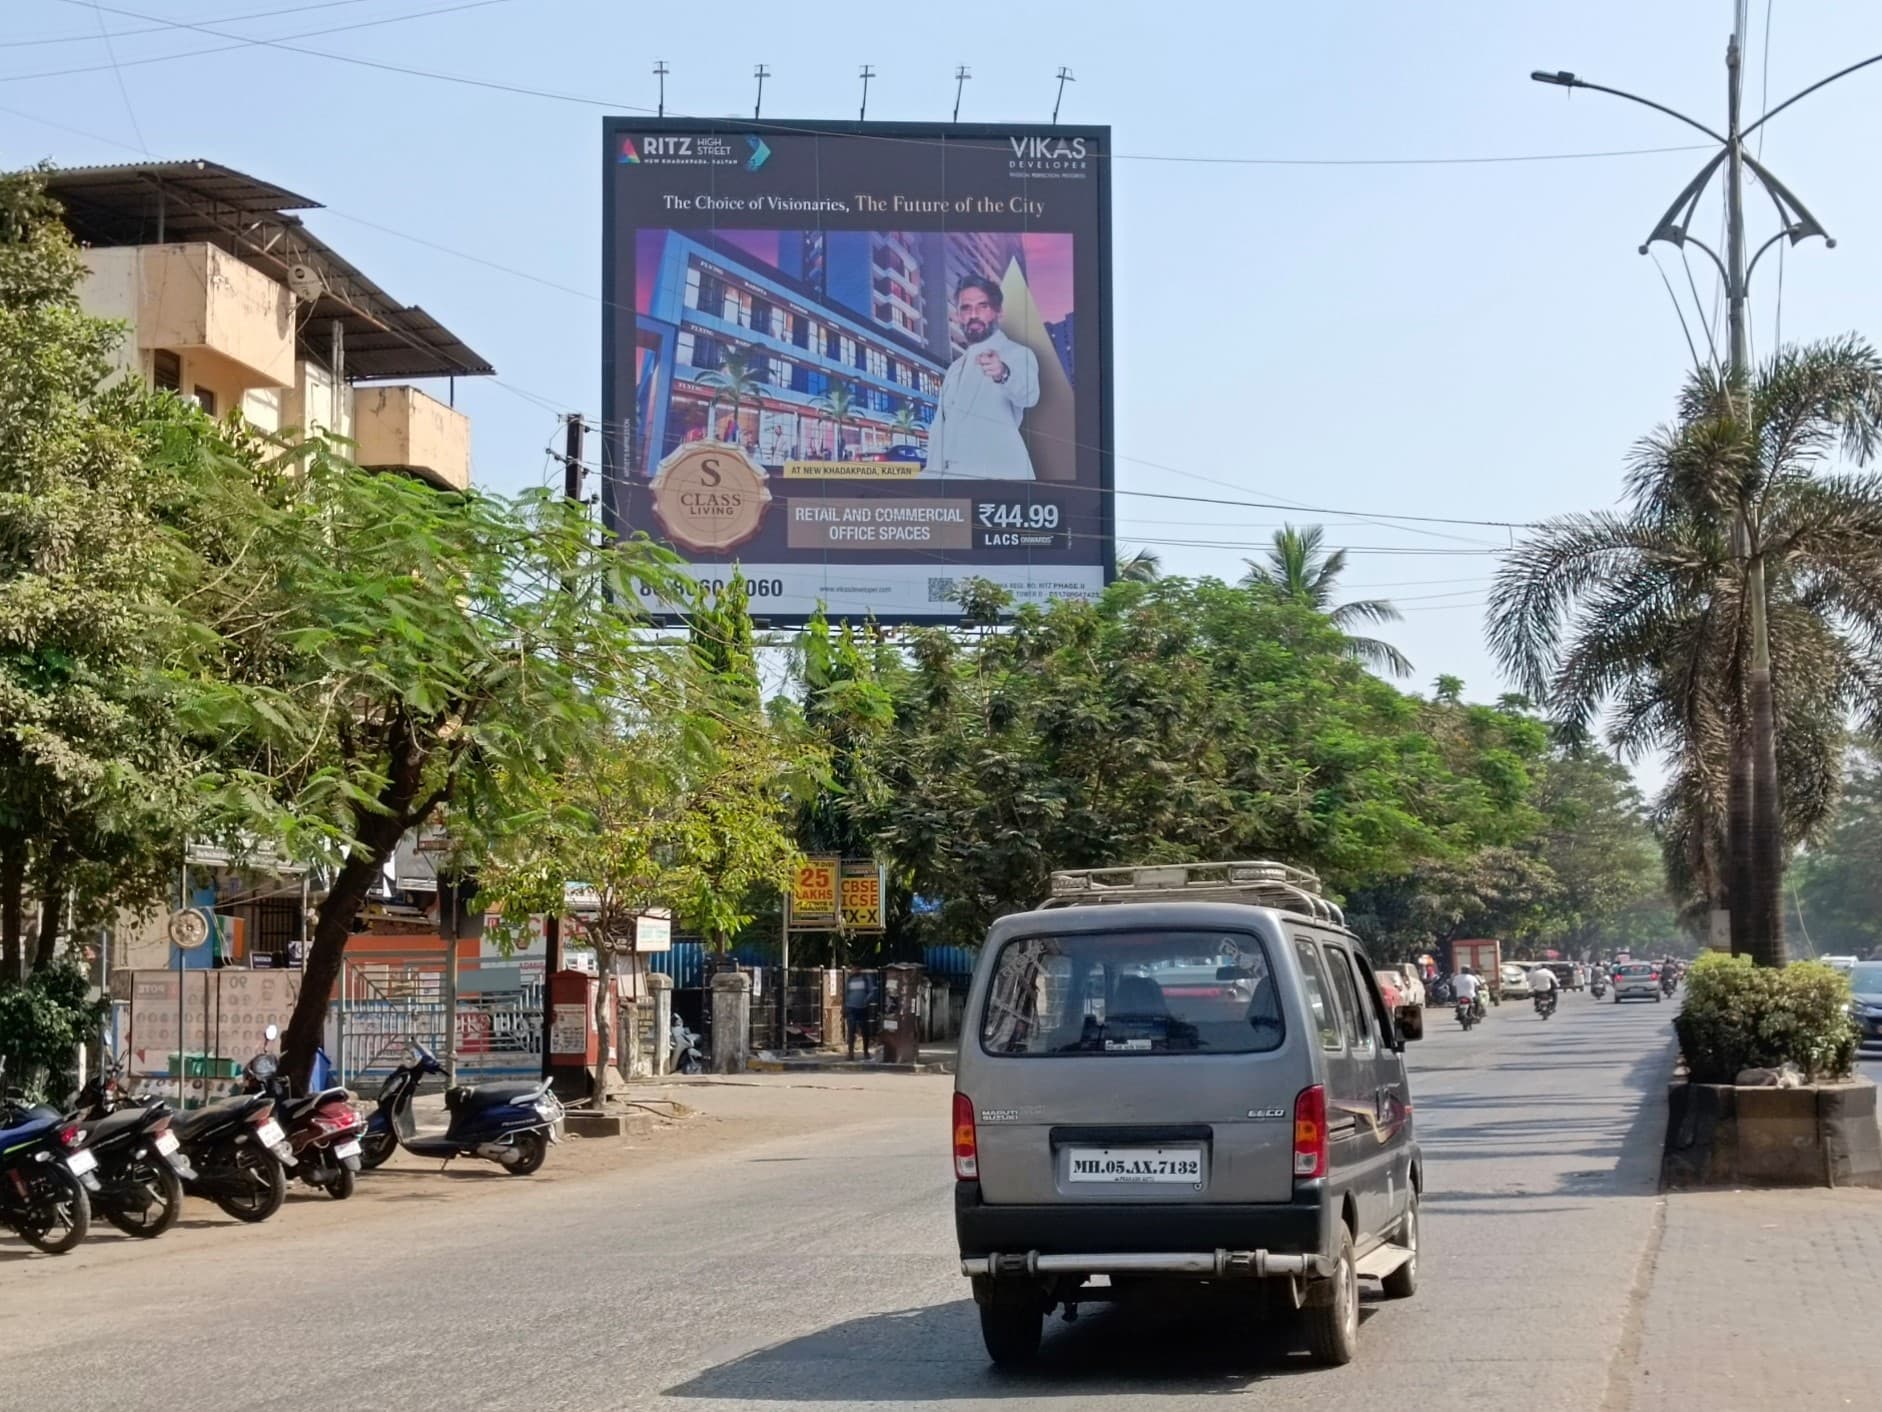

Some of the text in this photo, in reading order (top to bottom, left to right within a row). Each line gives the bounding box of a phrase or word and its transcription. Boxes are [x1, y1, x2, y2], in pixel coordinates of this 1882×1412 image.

[643, 137, 692, 155] RITZ
[697, 138, 722, 146] HIGH
[1009, 136, 1086, 159] VIKAS
[697, 146, 732, 155] STREET
[1009, 160, 1086, 169] DEVELOPER
[663, 194, 1045, 218] The Choice of Visionaries, The Future of the City
[700, 459, 721, 487] S
[791, 466, 912, 477] AT NEW KHADAKPADA, KALYAN
[680, 493, 742, 507] CLASS
[689, 506, 734, 516] LIVING
[795, 507, 965, 523] RETAIL AND COMMERCIAL
[978, 503, 1059, 529] ₹44.99
[829, 526, 931, 541] OFFICE SPACES
[984, 533, 1019, 546] LACS
[800, 868, 830, 888] 25
[841, 880, 878, 893] CBSE
[795, 889, 833, 900] LAKHS
[841, 894, 878, 907] ICSE
[1073, 1160, 1198, 1175] MH.05.AX.7132
